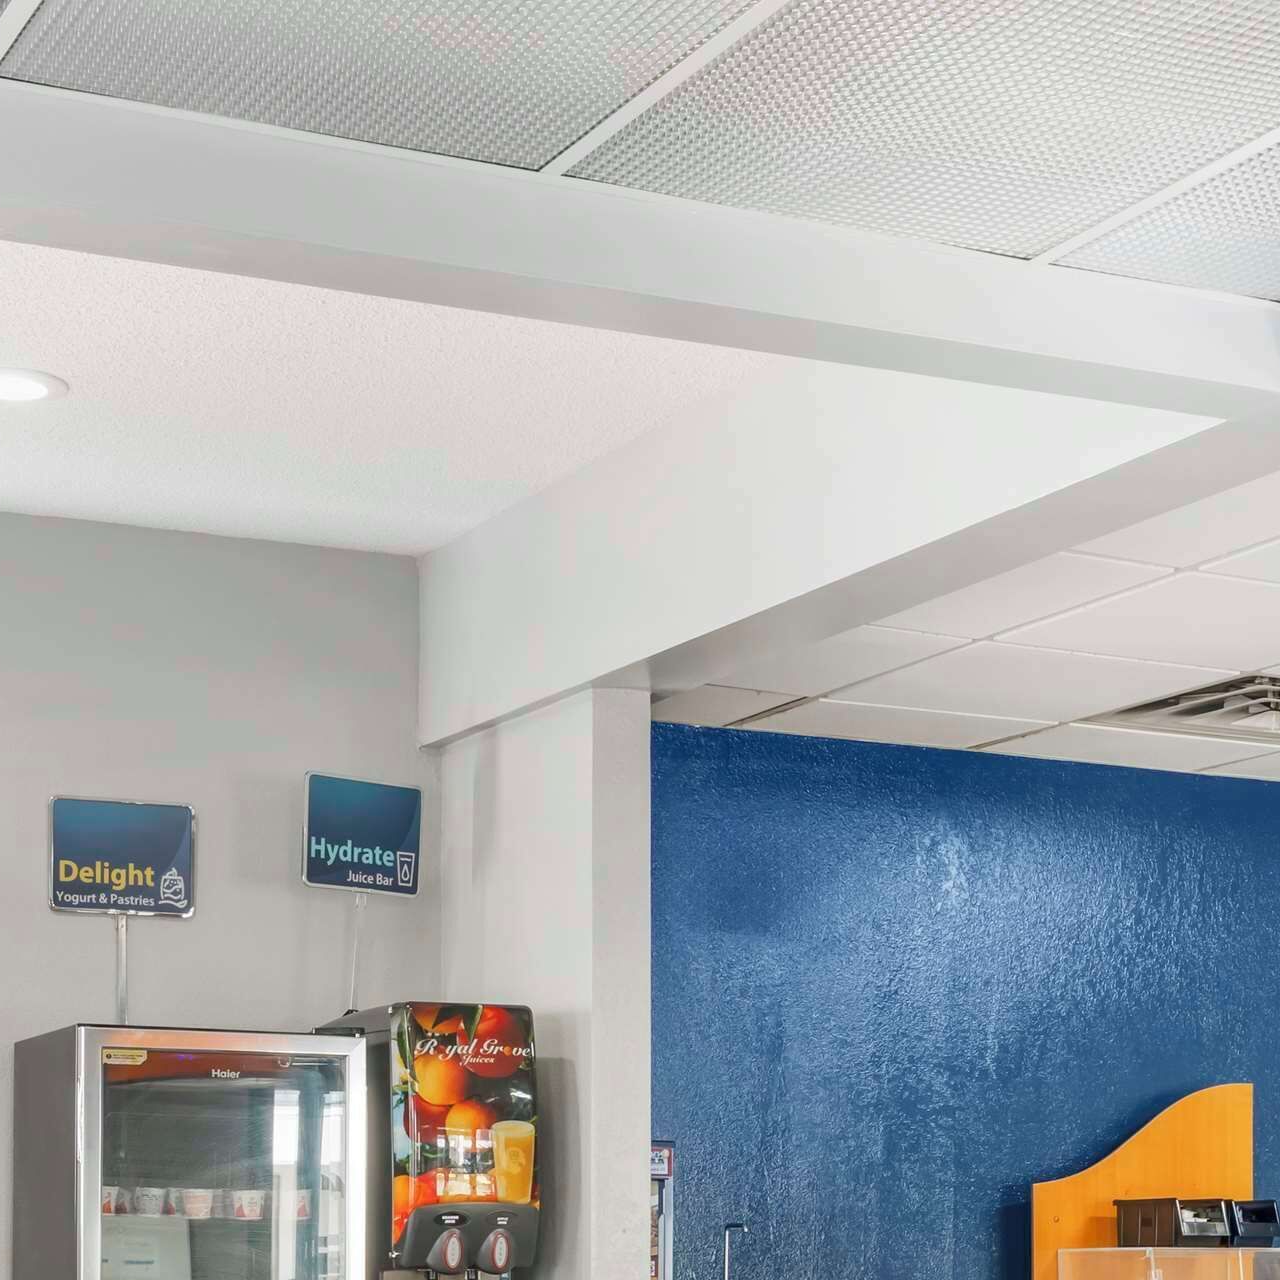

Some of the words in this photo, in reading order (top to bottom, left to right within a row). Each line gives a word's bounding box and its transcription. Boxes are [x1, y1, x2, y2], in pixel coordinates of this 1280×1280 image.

[310, 836, 395, 867] Hydrate
[59, 859, 155, 890] Delight
[346, 870, 374, 884] Juice
[376, 873, 394, 886] Bar
[56, 891, 97, 905] Yogurt
[99, 892, 108, 904] &
[110, 893, 155, 906] Pastries
[413, 1038, 478, 1060] Royal
[479, 1038, 531, 1057] Grove
[211, 1068, 241, 1079] Haier
